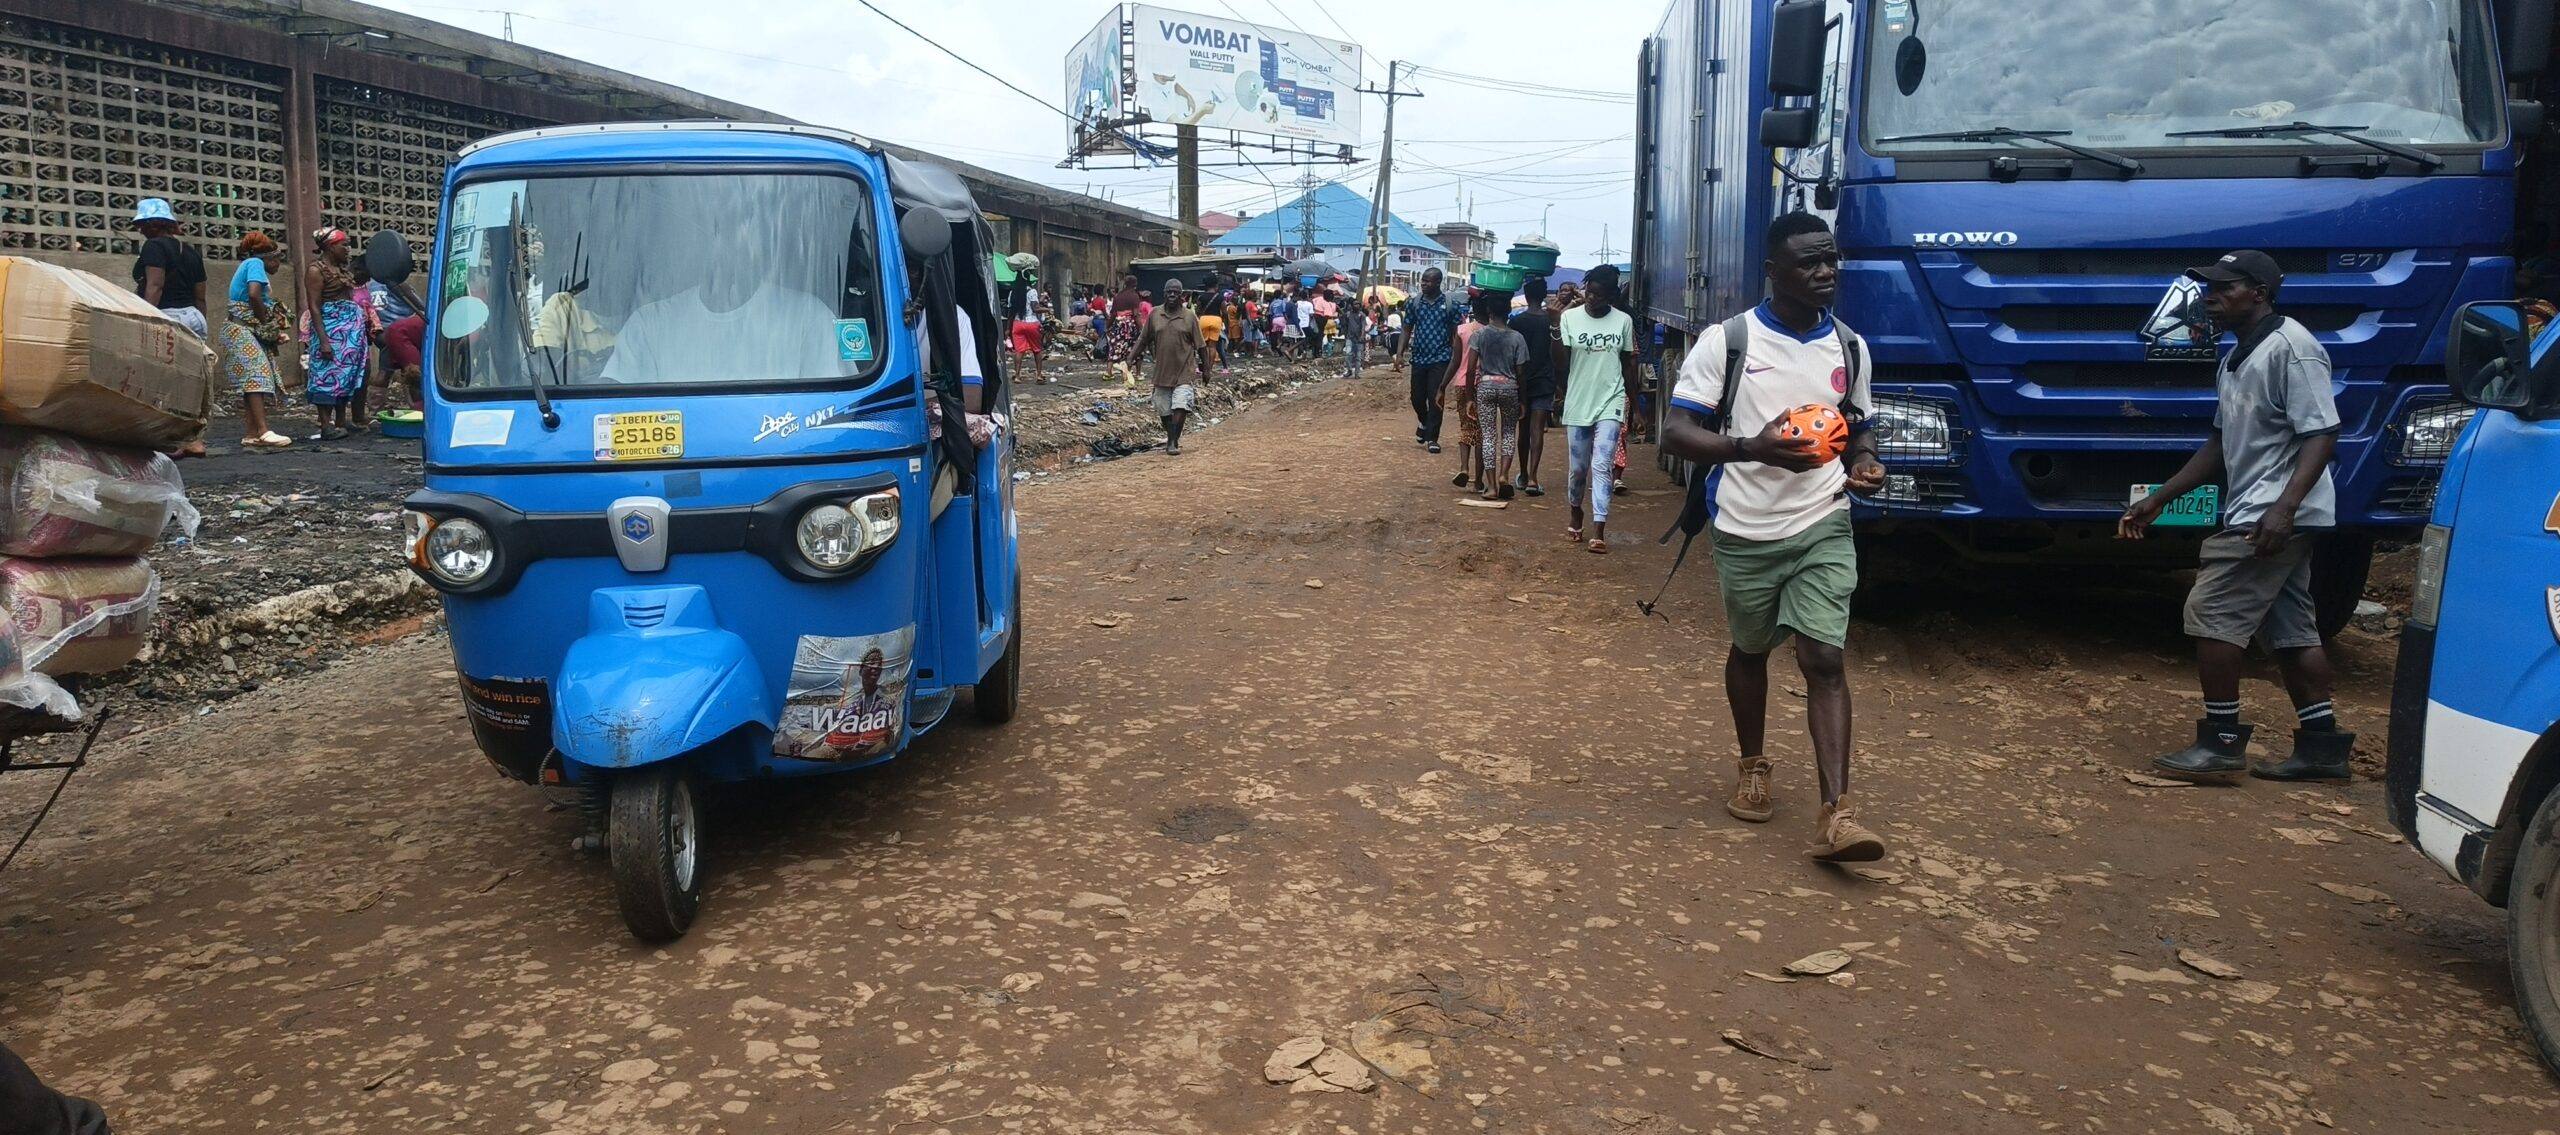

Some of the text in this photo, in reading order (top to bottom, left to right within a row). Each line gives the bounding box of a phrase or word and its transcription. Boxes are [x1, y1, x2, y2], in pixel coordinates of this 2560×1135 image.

[1159, 20, 1251, 53] VOMBAT
[1189, 49, 1235, 62] WALL PUTTY
[1300, 61, 1332, 73] VOMBAT
[1912, 231, 2018, 247] HOWO
[2338, 253, 2383, 267] 371
[805, 405, 835, 428] NXT
[614, 426, 676, 444] 25186
[2161, 496, 2214, 515] A0245
[492, 691, 513, 704] win
[516, 693, 541, 705] rice
